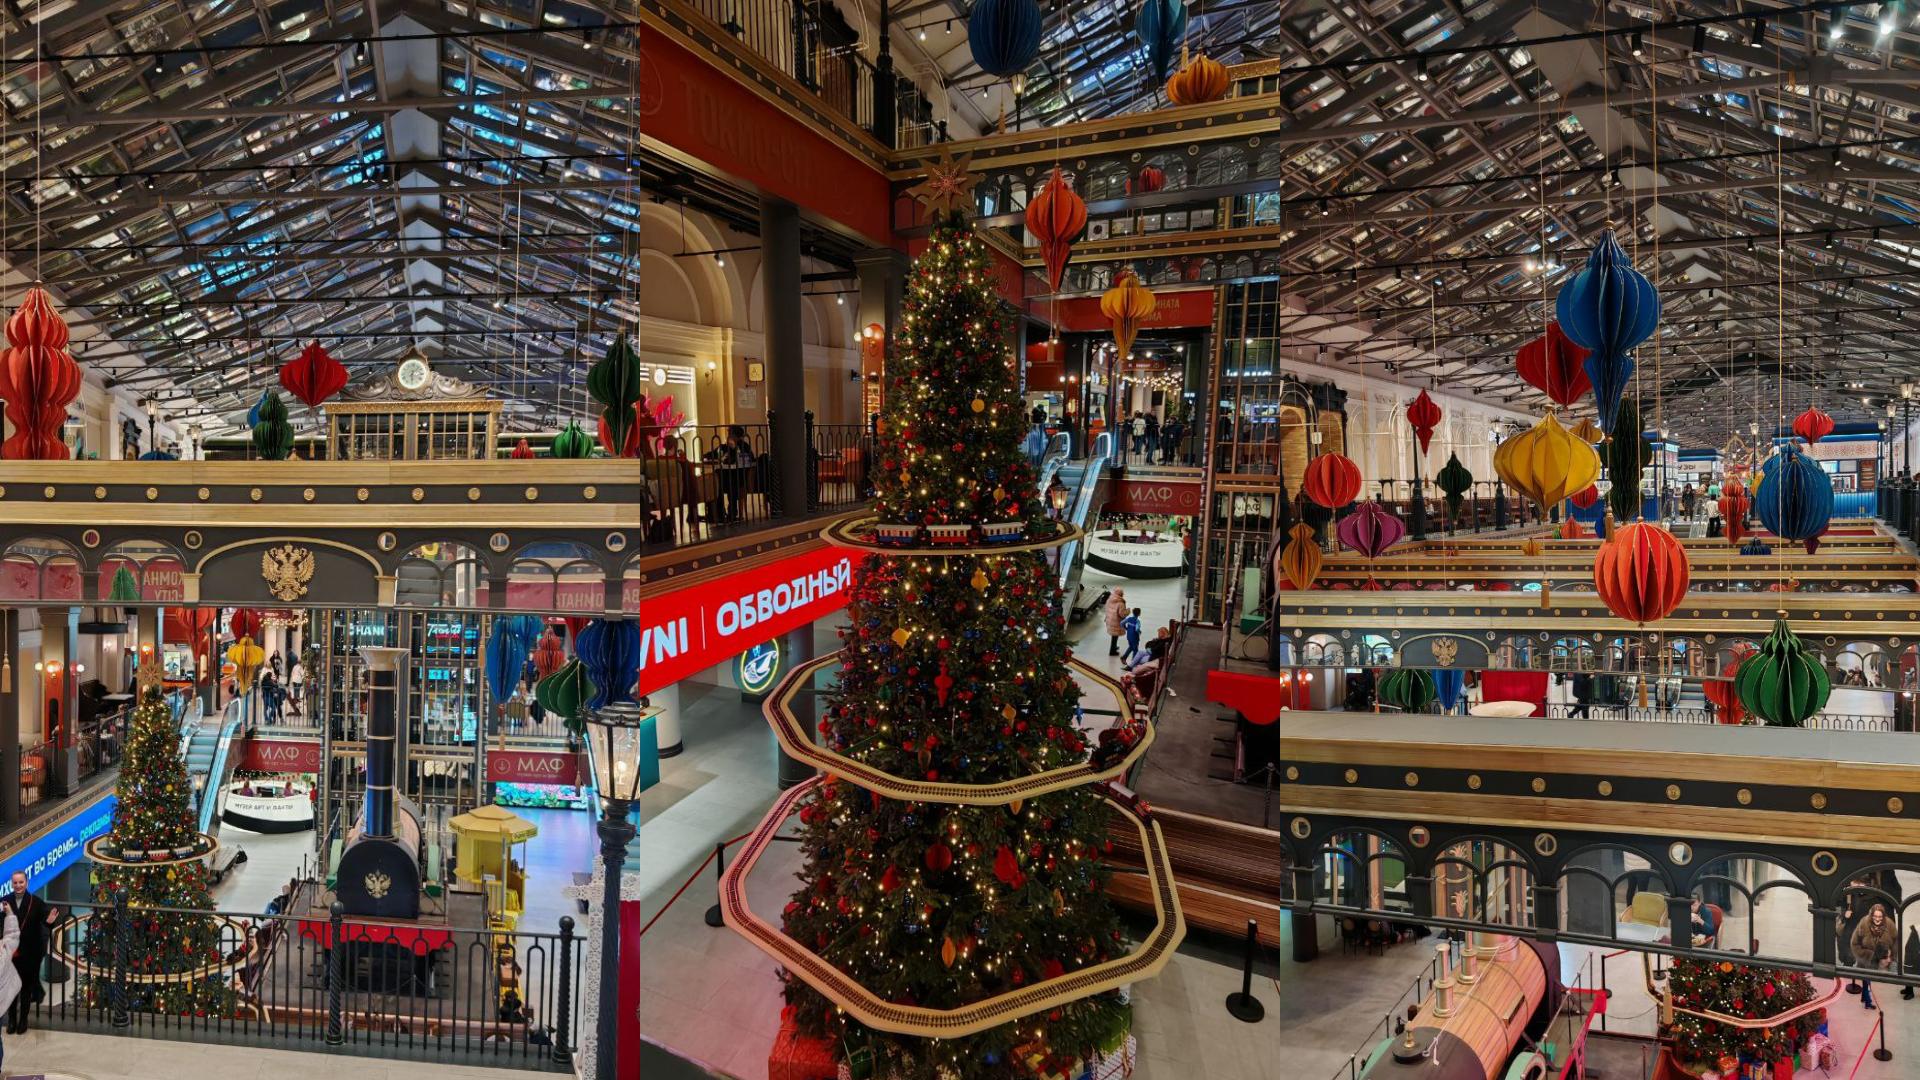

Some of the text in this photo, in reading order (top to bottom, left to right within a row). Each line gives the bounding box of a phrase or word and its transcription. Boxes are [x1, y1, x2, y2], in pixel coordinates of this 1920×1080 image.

[1126, 487, 1173, 502] МАФ
[716, 557, 851, 637] ОБВОДНЫЙ
[257, 746, 299, 760] МАФ
[517, 757, 565, 772] МАФ
[34, 857, 46, 876] во
